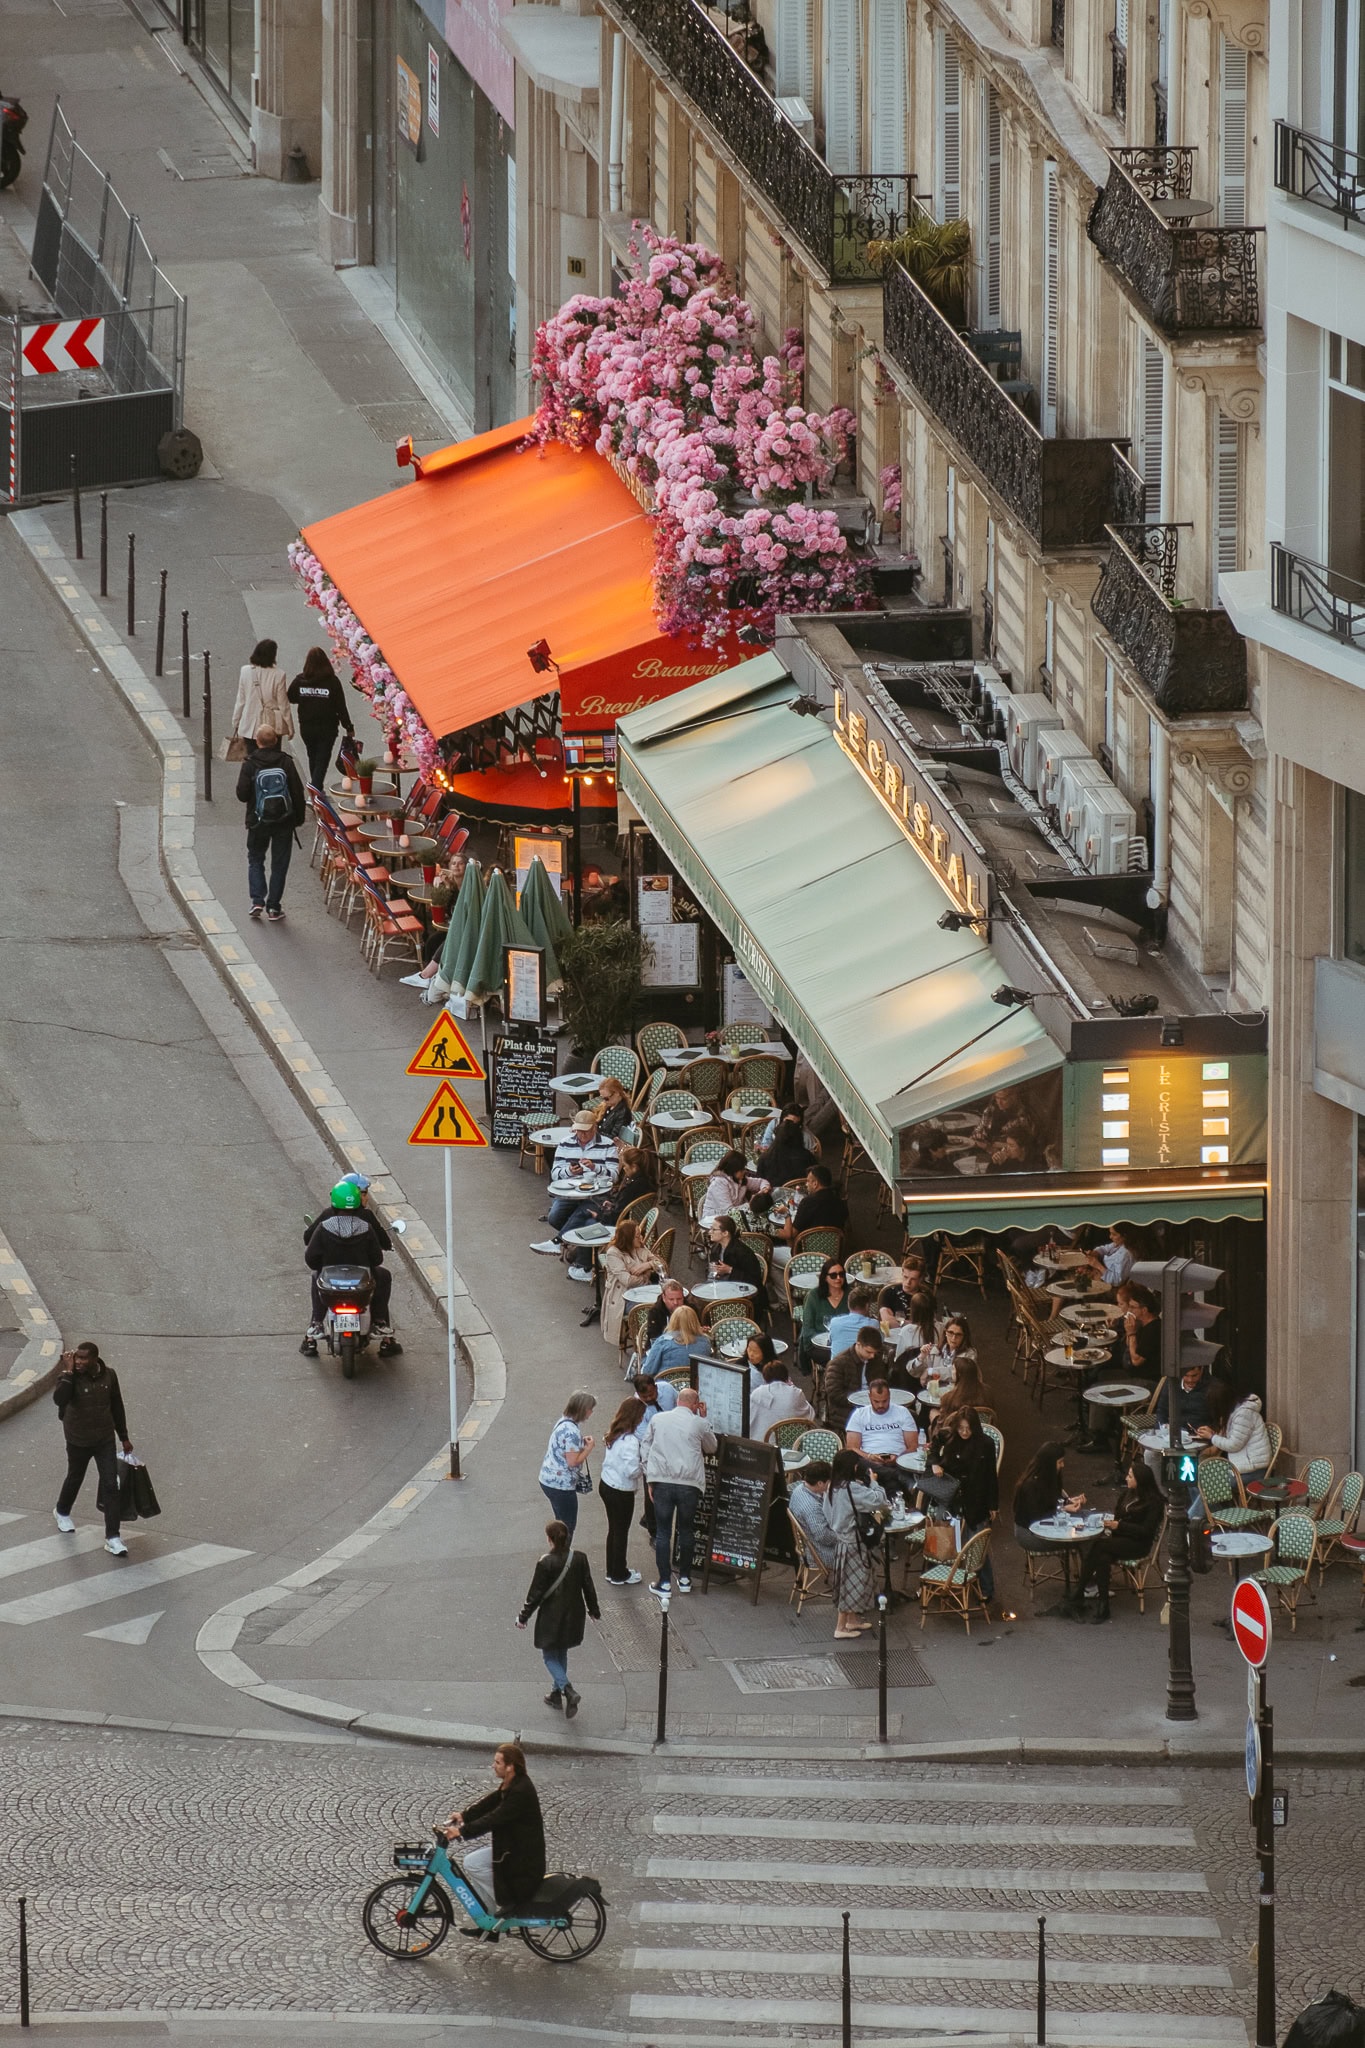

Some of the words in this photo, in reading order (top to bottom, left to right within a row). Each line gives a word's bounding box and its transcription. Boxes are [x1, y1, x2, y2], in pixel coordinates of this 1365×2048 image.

[570, 260, 581, 273] 10
[632, 658, 728, 678] Brasserie
[834, 689, 862, 752] LE
[867, 739, 978, 916] CRISTAL
[738, 924, 748, 956] LE
[747, 938, 775, 997] CRISTAL
[503, 1039, 523, 1050] Plat
[524, 1041, 536, 1051] du
[536, 1043, 556, 1054] jour
[1159, 1065, 1170, 1085] LE
[1157, 1091, 1172, 1164] CRISTAL
[865, 1423, 900, 1431] LEGEND
[456, 1886, 475, 1909] dott
